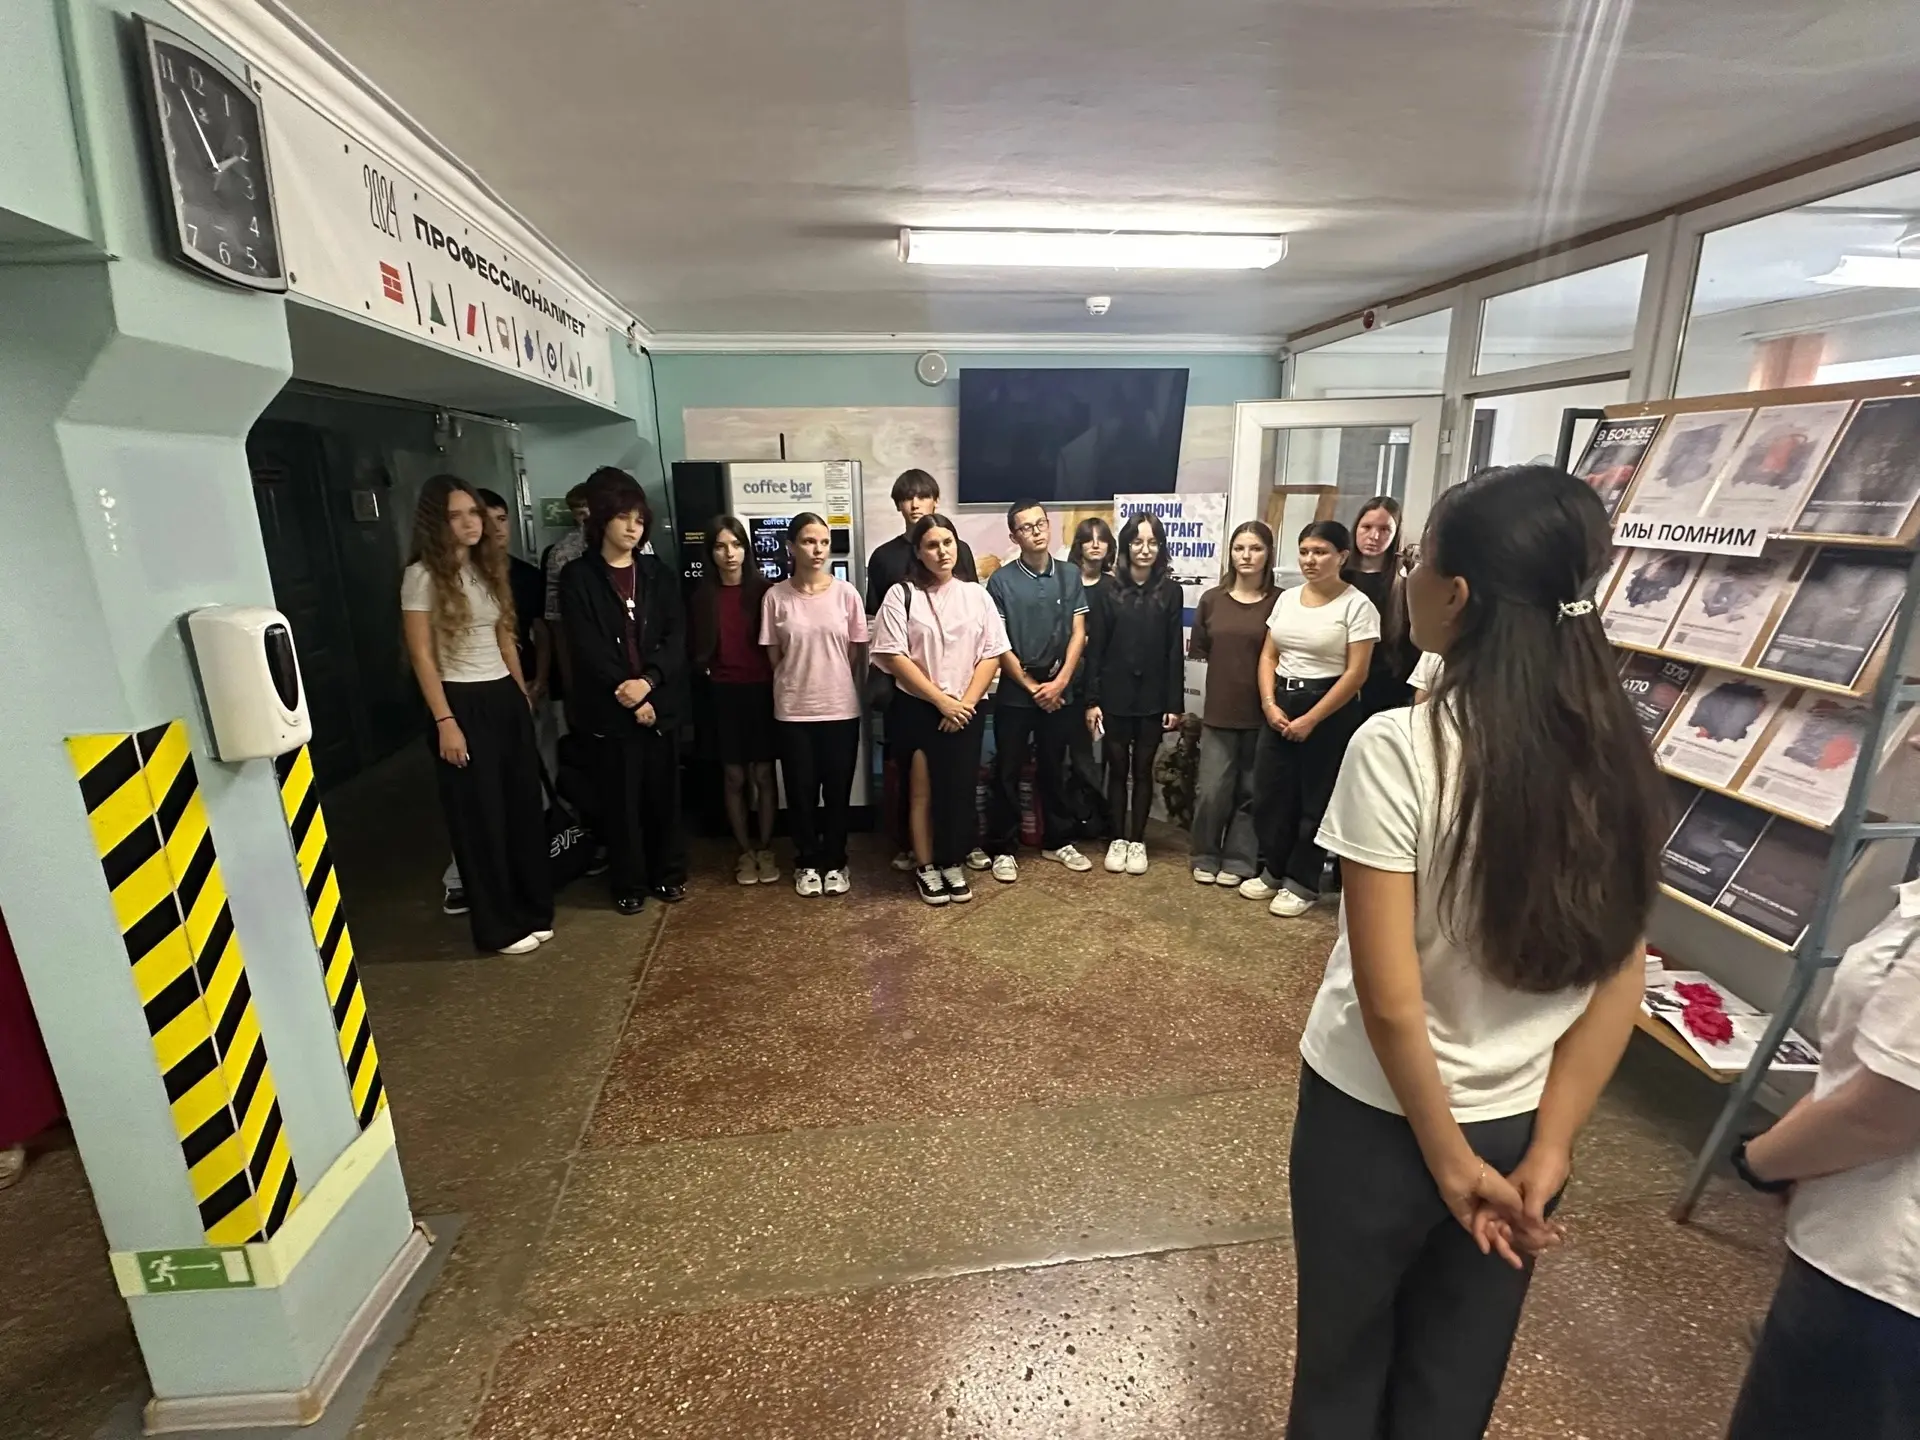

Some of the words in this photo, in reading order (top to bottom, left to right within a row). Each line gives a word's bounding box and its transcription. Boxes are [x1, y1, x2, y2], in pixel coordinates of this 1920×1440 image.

[223, 93, 230, 117] 1
[187, 223, 198, 248] 7
[249, 216, 260, 238] 4
[219, 241, 231, 266] 6
[245, 246, 258, 270] 5
[363, 164, 402, 243] 2024
[412, 213, 586, 338] ПРОФЕССИОНАЛИТЕТ
[1597, 429, 1607, 441] В
[1607, 426, 1654, 441] БОРЬБЕ
[744, 480, 788, 494] coffee
[790, 479, 812, 493] bar
[1164, 522, 1203, 537] ТРАКТ
[1620, 522, 1654, 539] МЫ
[1657, 524, 1757, 547] ПОМНИМ
